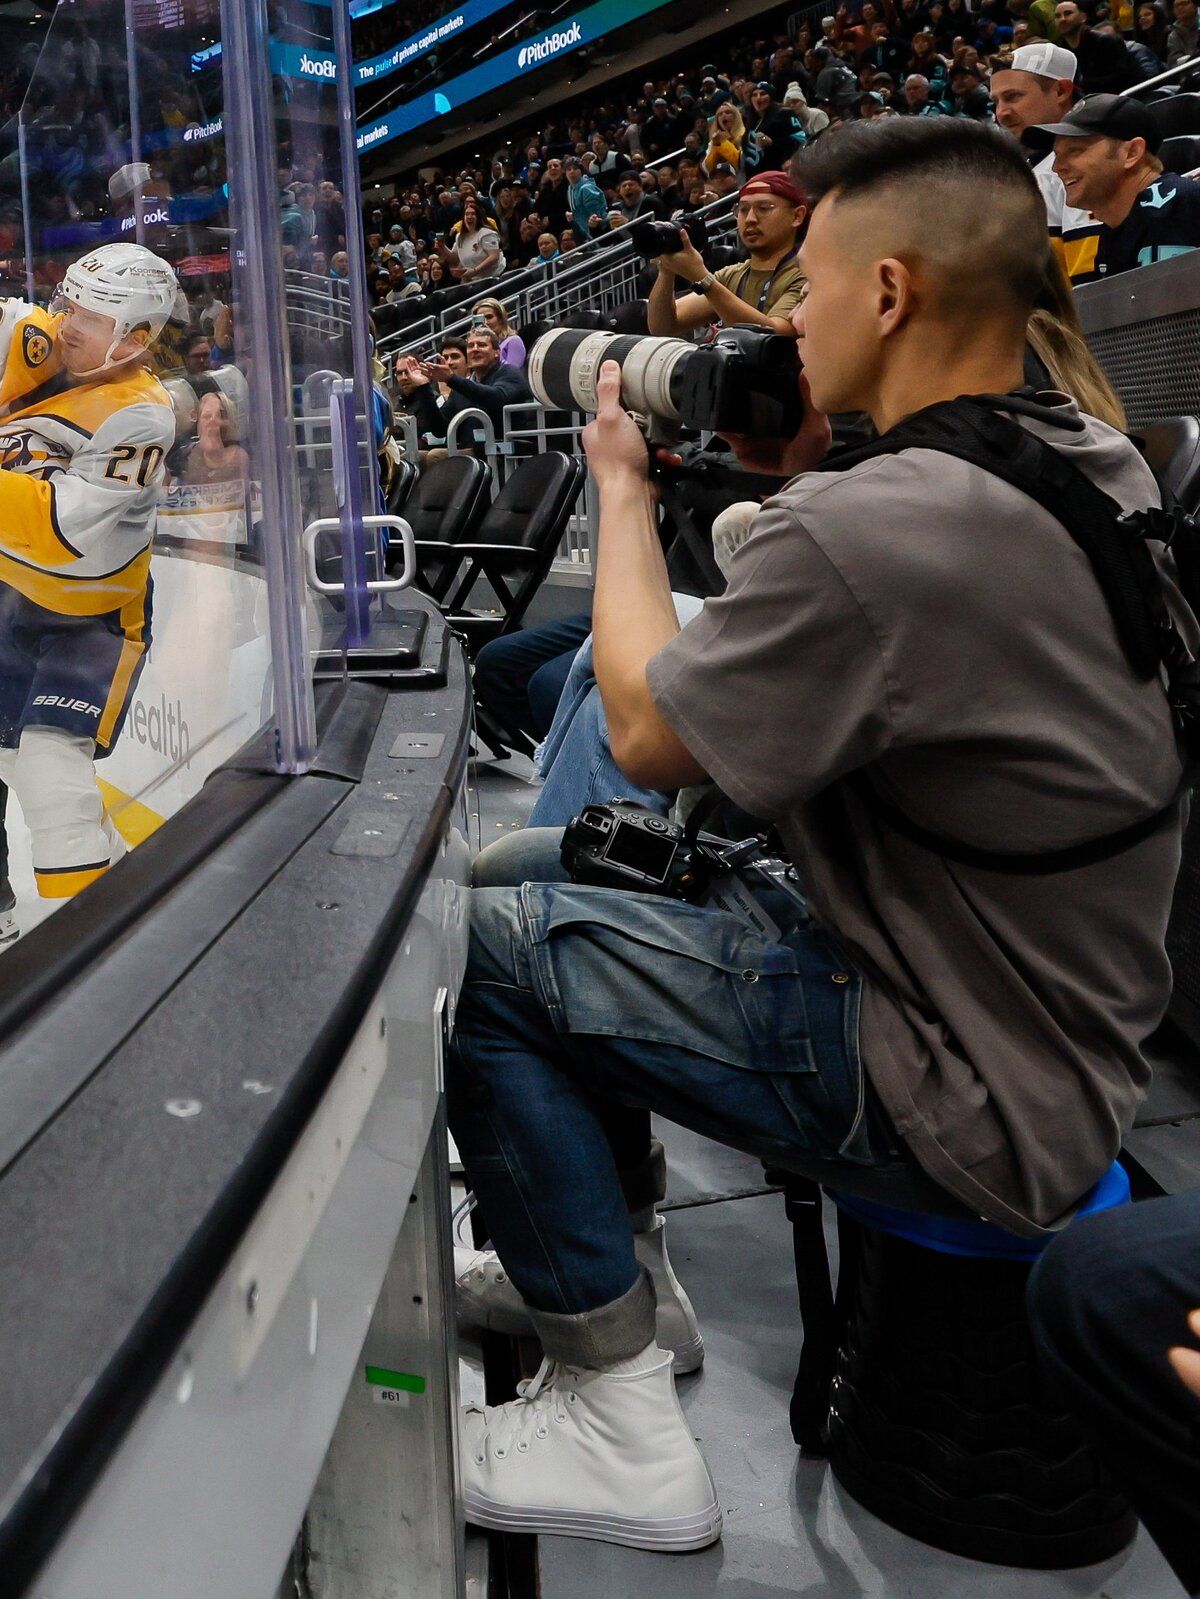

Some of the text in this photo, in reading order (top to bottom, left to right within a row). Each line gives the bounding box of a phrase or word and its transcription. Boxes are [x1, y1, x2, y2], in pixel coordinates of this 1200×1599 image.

[359, 15, 464, 79] The pulse of private capital markets
[526, 22, 582, 65] PitchBook
[194, 118, 223, 140] PitchBook
[364, 124, 389, 145] markets
[81, 257, 105, 273] 20
[100, 444, 164, 490] 20
[32, 695, 102, 718] BAUER
[382, 1390, 400, 1402] #61
